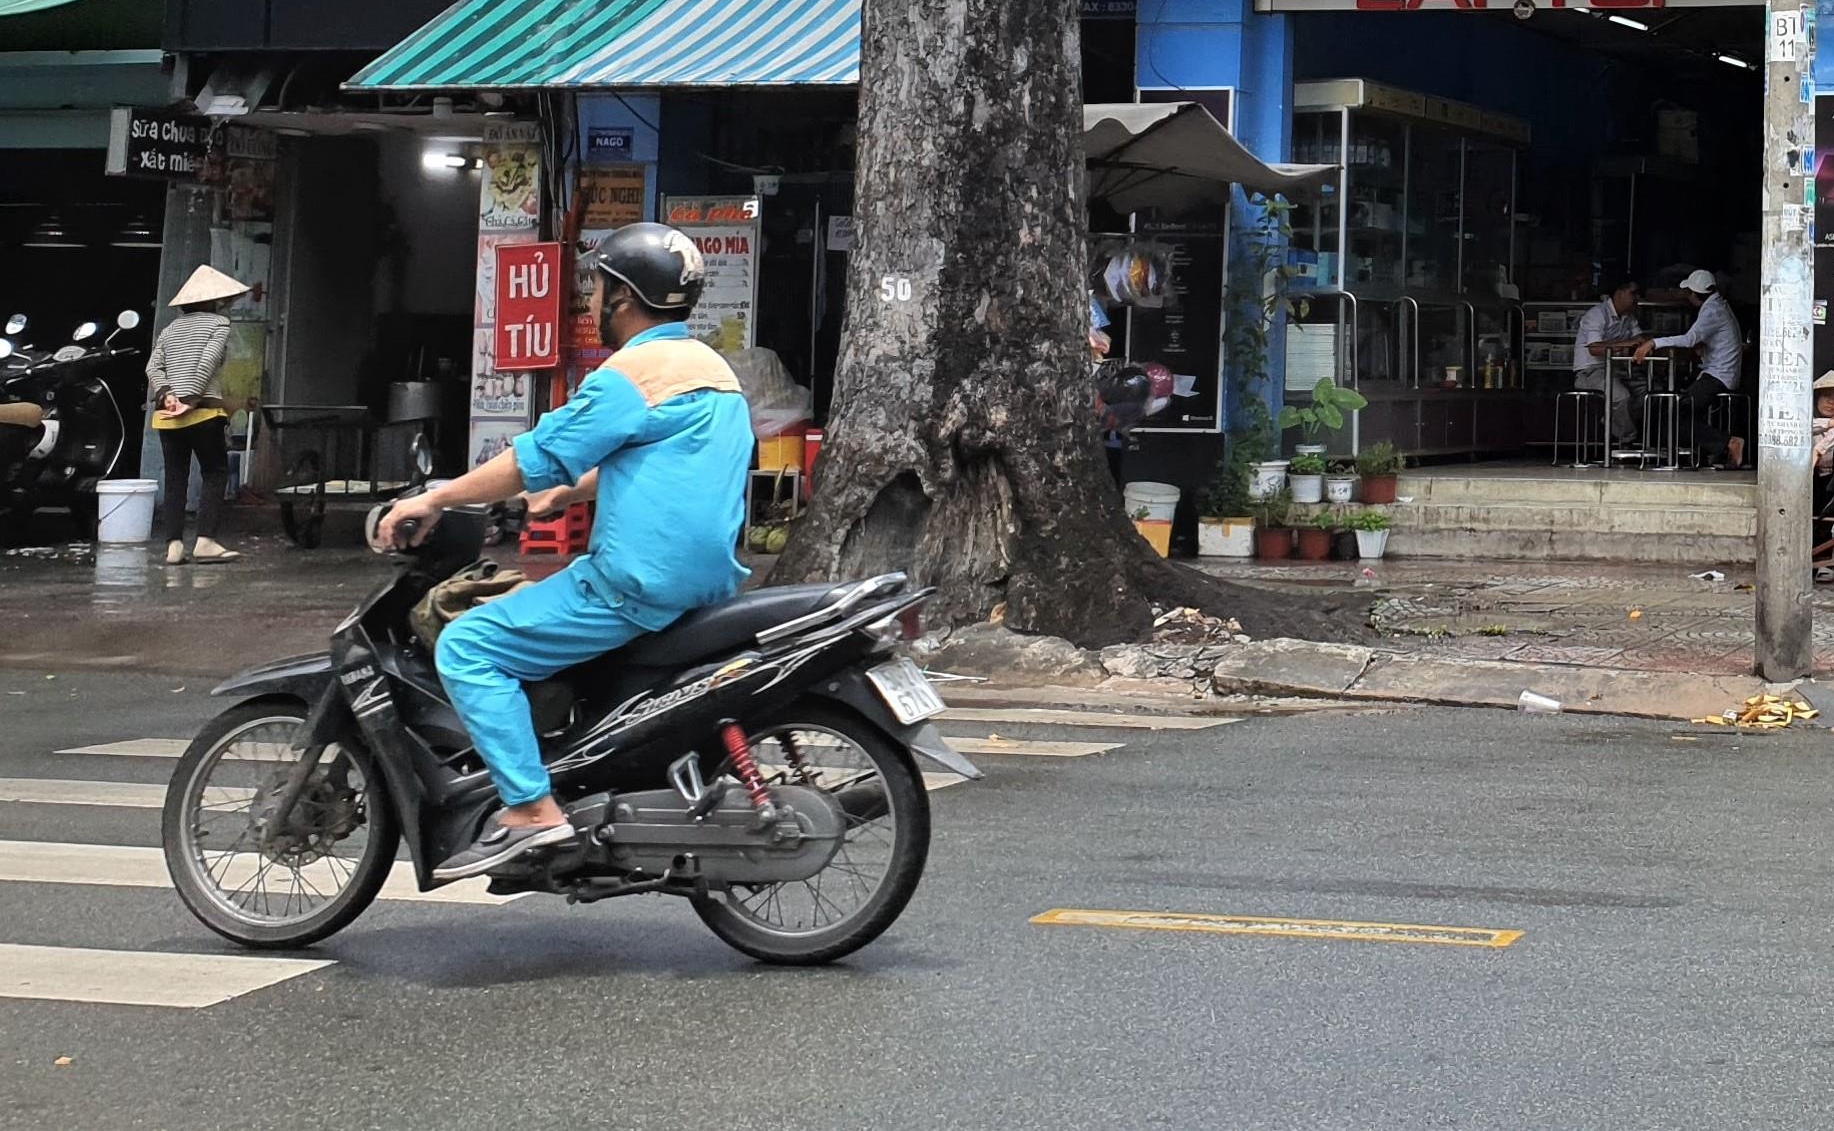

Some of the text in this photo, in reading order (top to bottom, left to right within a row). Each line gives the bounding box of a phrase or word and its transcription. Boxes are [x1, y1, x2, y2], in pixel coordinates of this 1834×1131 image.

[509, 251, 549, 299] HỦ
[881, 277, 912, 302] 50
[504, 314, 551, 358] TÍU
